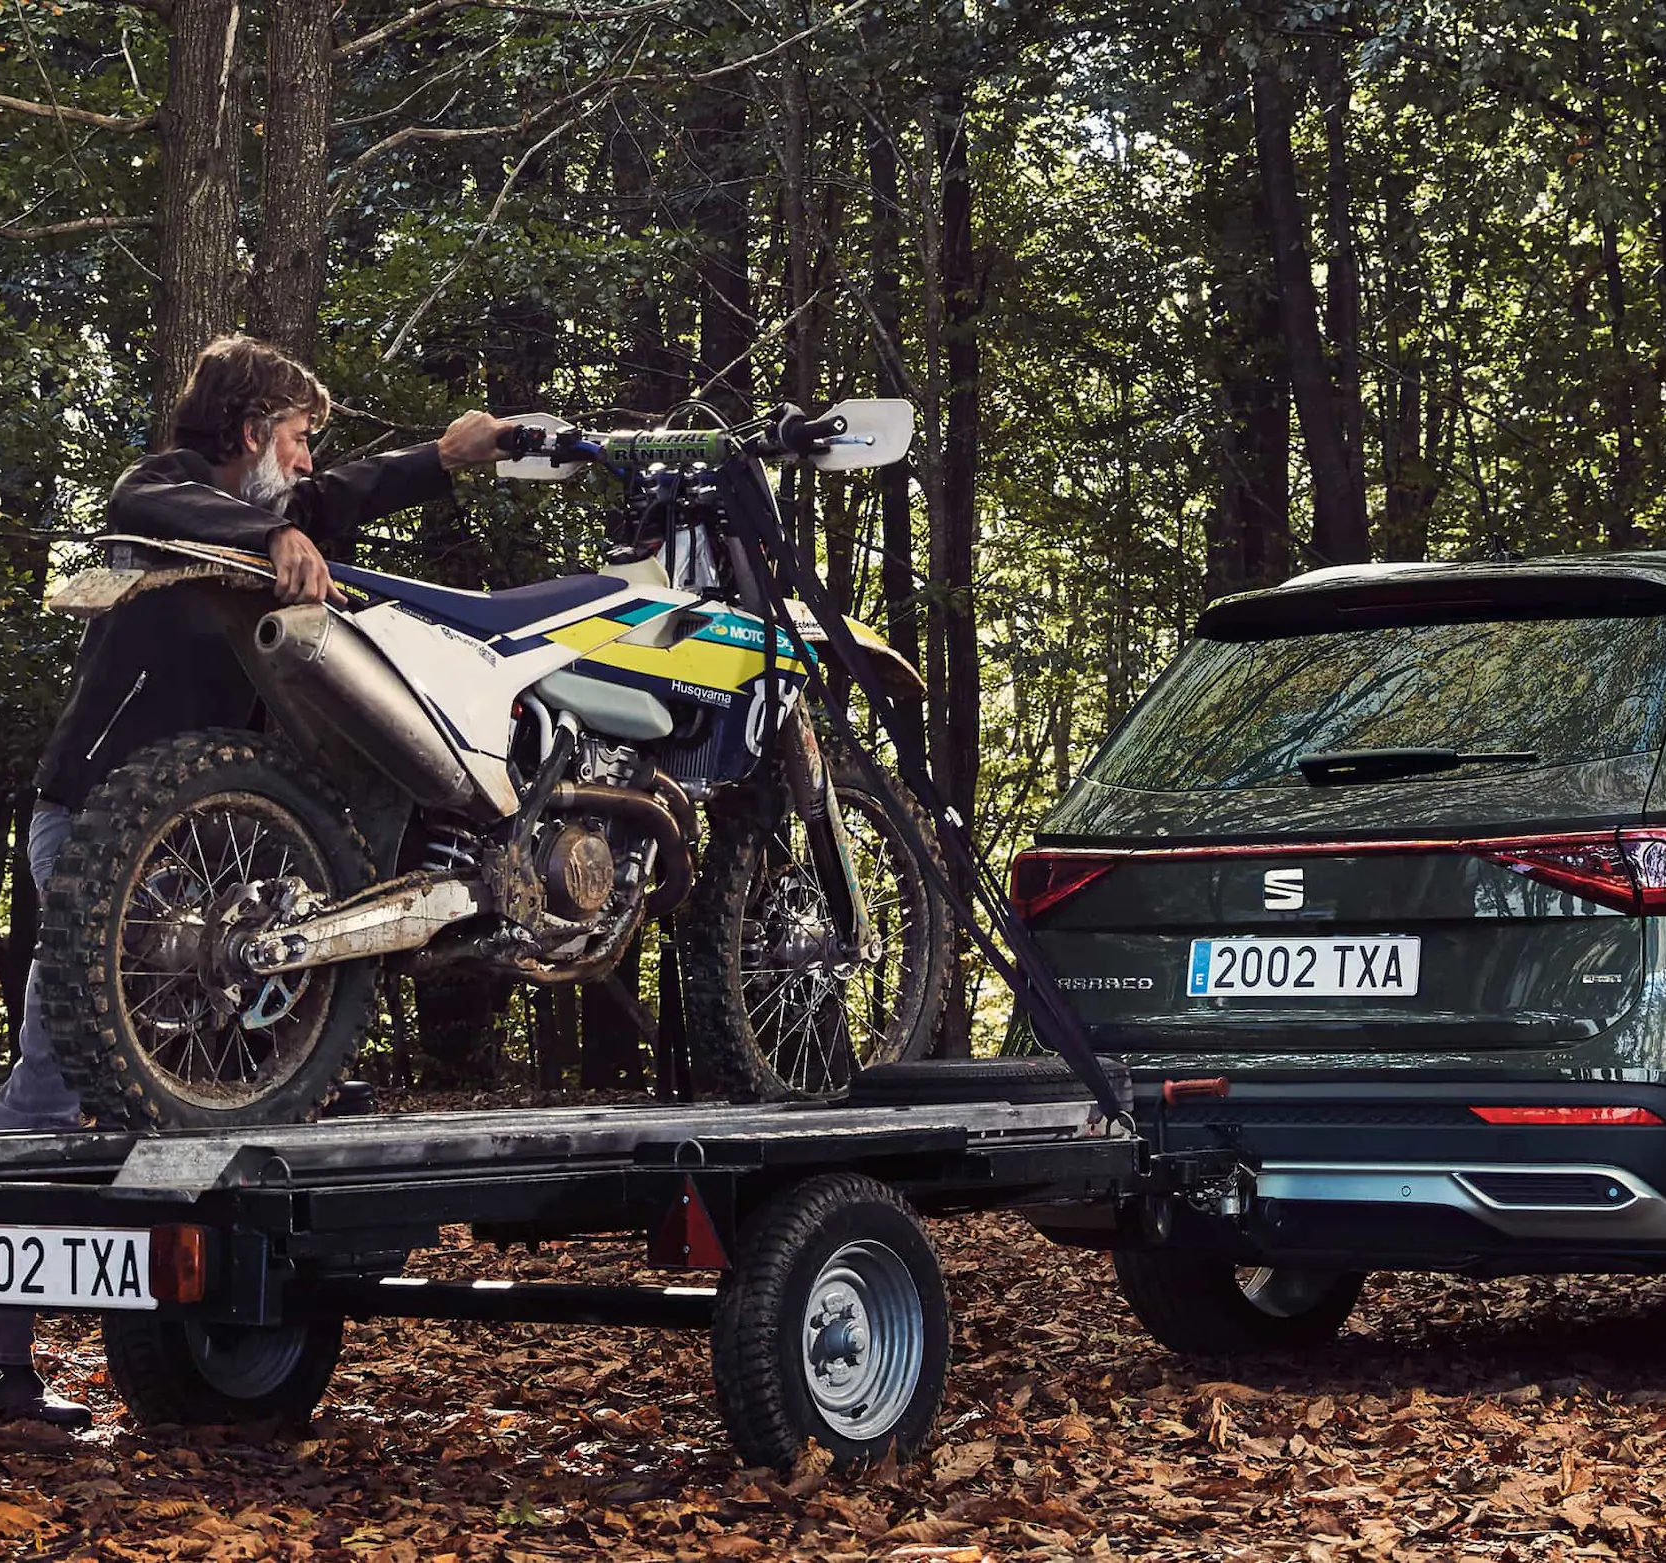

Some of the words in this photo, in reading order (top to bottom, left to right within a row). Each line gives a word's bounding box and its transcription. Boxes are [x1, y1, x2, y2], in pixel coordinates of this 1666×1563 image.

[729, 625, 795, 652] MOTOEX
[671, 679, 732, 704] Husqvarna
[1195, 973, 1204, 985] E
[1214, 945, 1317, 988] 2002
[1333, 945, 1403, 988] TXA
[1053, 977, 1154, 990] ARRACO
[62, 1237, 141, 1298] TXA
